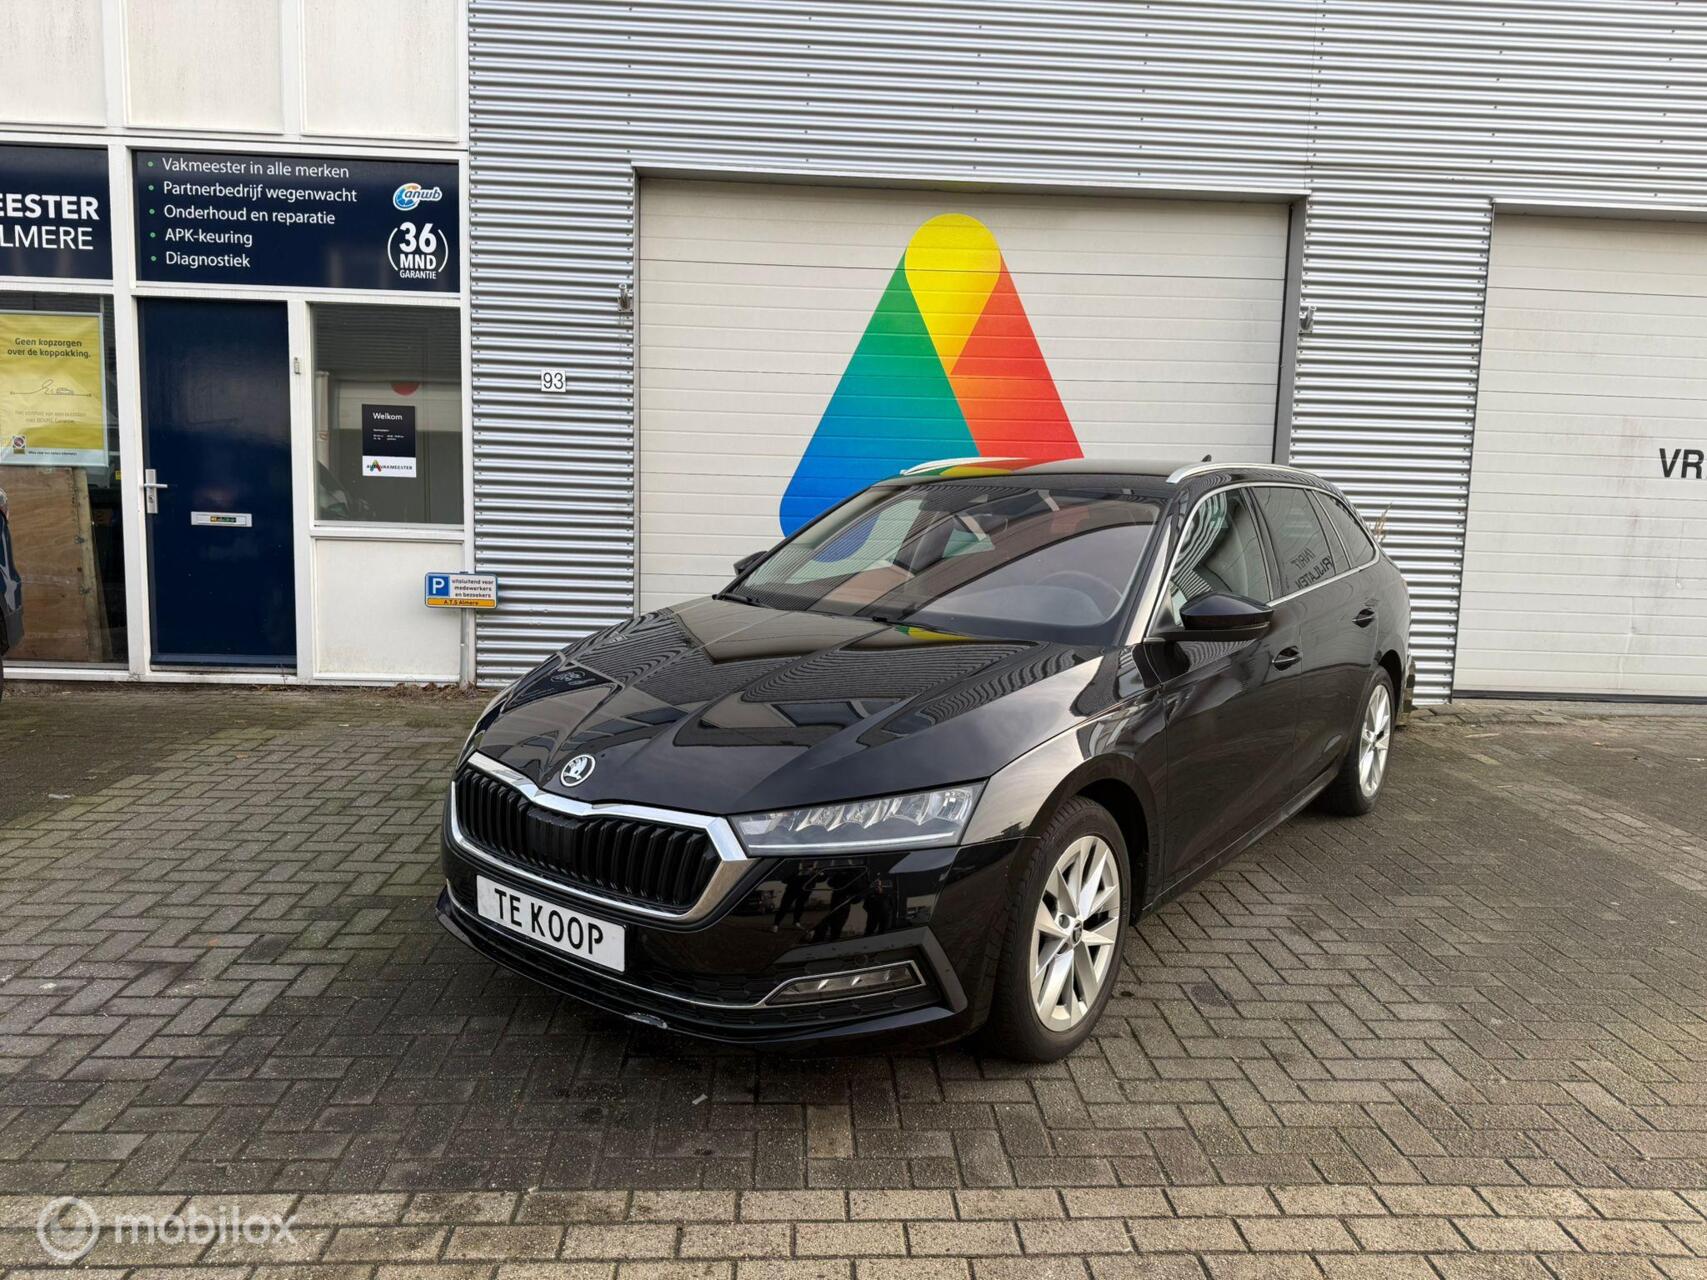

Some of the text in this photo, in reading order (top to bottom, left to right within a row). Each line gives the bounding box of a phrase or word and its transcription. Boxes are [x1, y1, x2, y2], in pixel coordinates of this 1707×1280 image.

[162, 157, 349, 178] Vakmeester in alle merken
[163, 181, 358, 203] Partnerbedrijf wegenwacht
[404, 187, 441, 200] anwb
[164, 204, 336, 226] Onderhoud en reparatie
[0, 224, 94, 250] LMERE
[165, 227, 253, 248] APK-keuring
[399, 221, 437, 254] 36
[165, 251, 251, 269] Diagnostiek
[399, 253, 437, 269] MND
[399, 269, 437, 280] GARANTIE
[15, 337, 82, 348] Geen kopzorgen
[7, 348, 92, 359] over de koppakking.
[543, 372, 564, 389] 93
[372, 412, 403, 421] Welkom
[494, 888, 604, 955] TE KOOP
